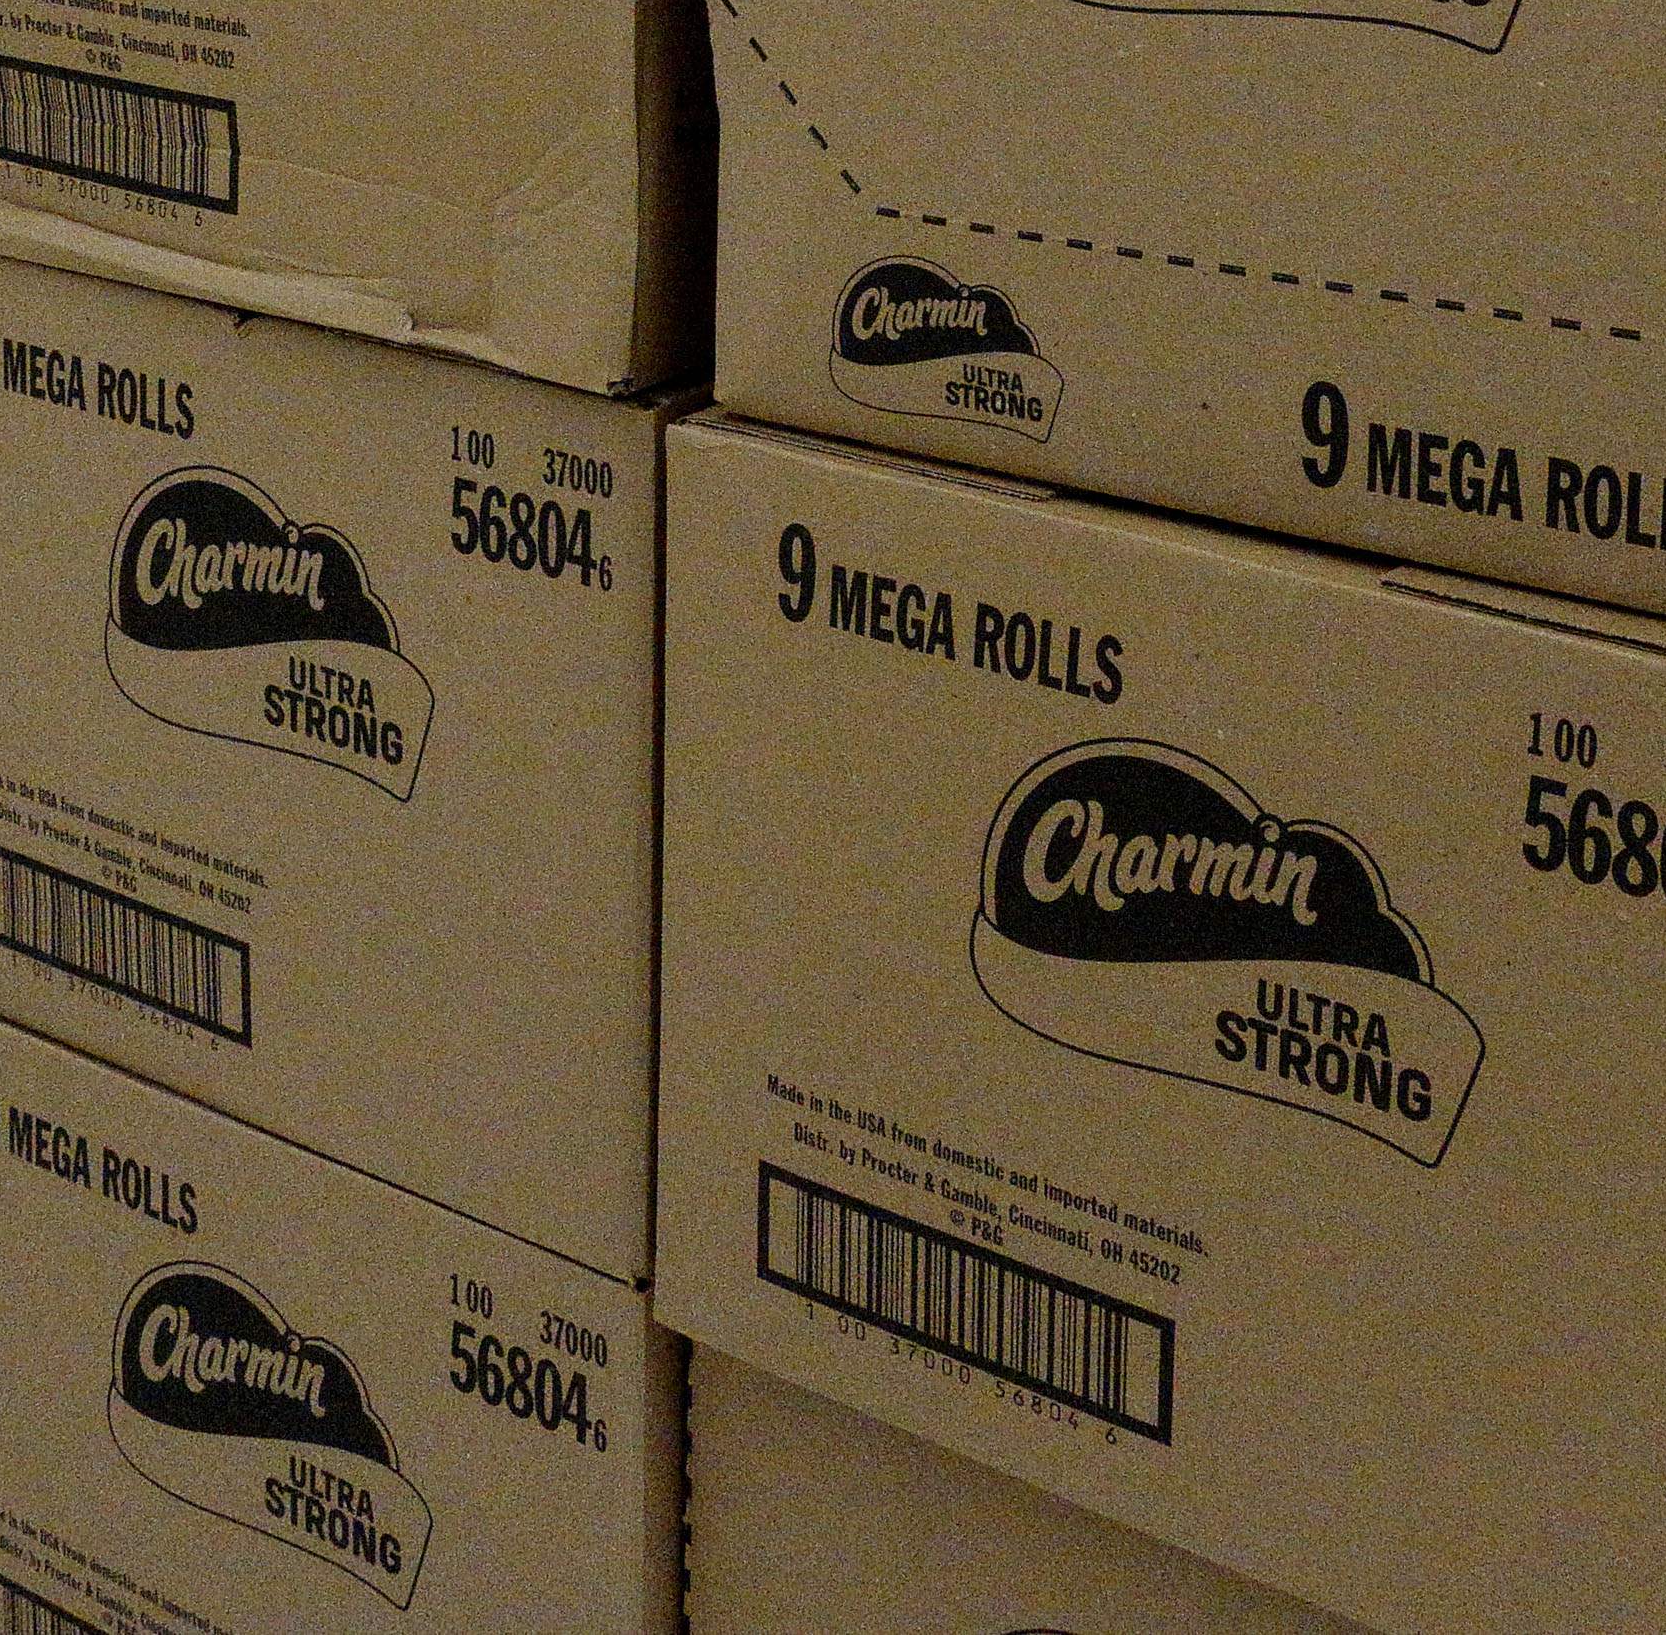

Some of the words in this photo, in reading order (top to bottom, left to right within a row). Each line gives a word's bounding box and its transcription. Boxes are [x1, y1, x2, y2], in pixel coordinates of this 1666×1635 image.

[3, 337, 87, 410] MEGA
[97, 361, 194, 441] ROLLS
[946, 381, 1043, 421] STRONG
[964, 364, 1023, 393] ULTRA
[542, 447, 613, 499] 37000
[1302, 380, 1350, 488] 9
[1366, 421, 1524, 522] MEGA
[136, 517, 324, 611] Charmin
[776, 523, 817, 623] 9
[829, 564, 956, 663] MEGA
[973, 602, 1124, 705] ROLLS
[264, 684, 403, 765] STRONG
[288, 655, 375, 713] ULTRA
[1021, 799, 1319, 926] Charmin
[1256, 978, 1392, 1058] ULTRA
[1215, 1010, 1433, 1124] STRONG
[767, 1074, 805, 1107] Made
[809, 1094, 823, 1114] in
[828, 1099, 853, 1126] the
[856, 1109, 887, 1139] USA
[891, 1122, 928, 1153] from
[932, 1139, 1005, 1182] domestic
[1010, 1167, 1038, 1193] and
[1043, 1174, 1118, 1226] imported
[1123, 1208, 1209, 1256] materials.
[839, 1140, 856, 1165] by
[861, 1148, 918, 1186] Procter
[924, 1172, 935, 1193] &
[1100, 1239, 1123, 1264] OH
[1133, 1248, 1181, 1285] 45202
[1105, 1427, 1117, 1445] 6
